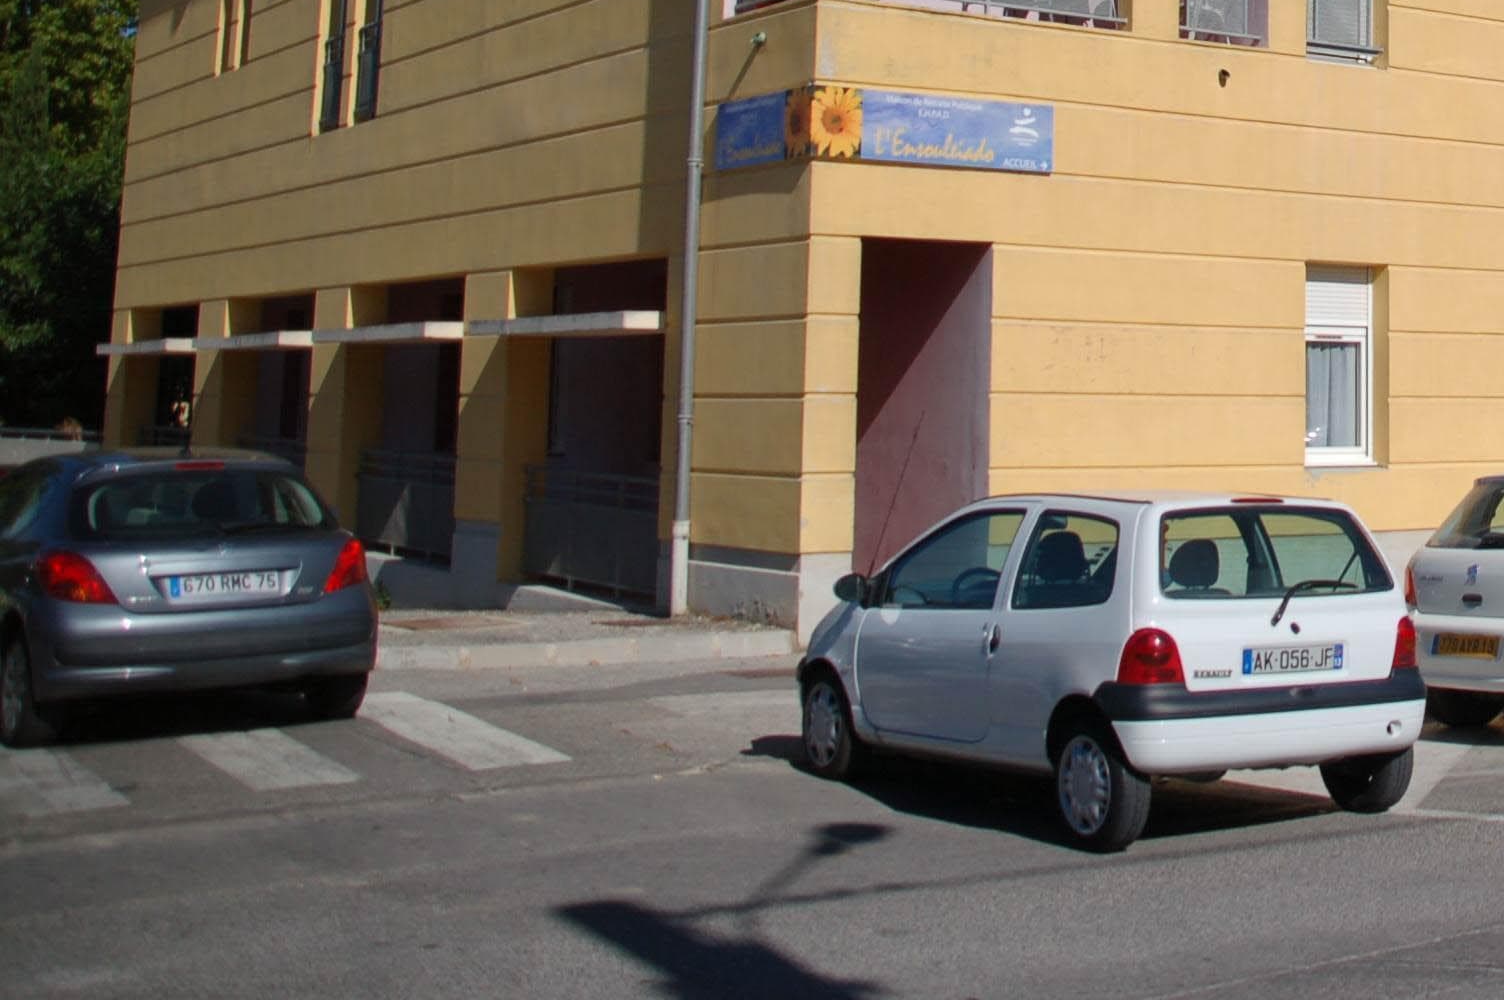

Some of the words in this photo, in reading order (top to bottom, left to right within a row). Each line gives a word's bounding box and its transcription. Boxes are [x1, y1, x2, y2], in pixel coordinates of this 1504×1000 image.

[1003, 157, 1038, 170] ACCUEIL
[183, 576, 216, 593] 670
[220, 574, 252, 591] RMC
[255, 572, 277, 589] 75
[1193, 669, 1232, 679] RENAULT
